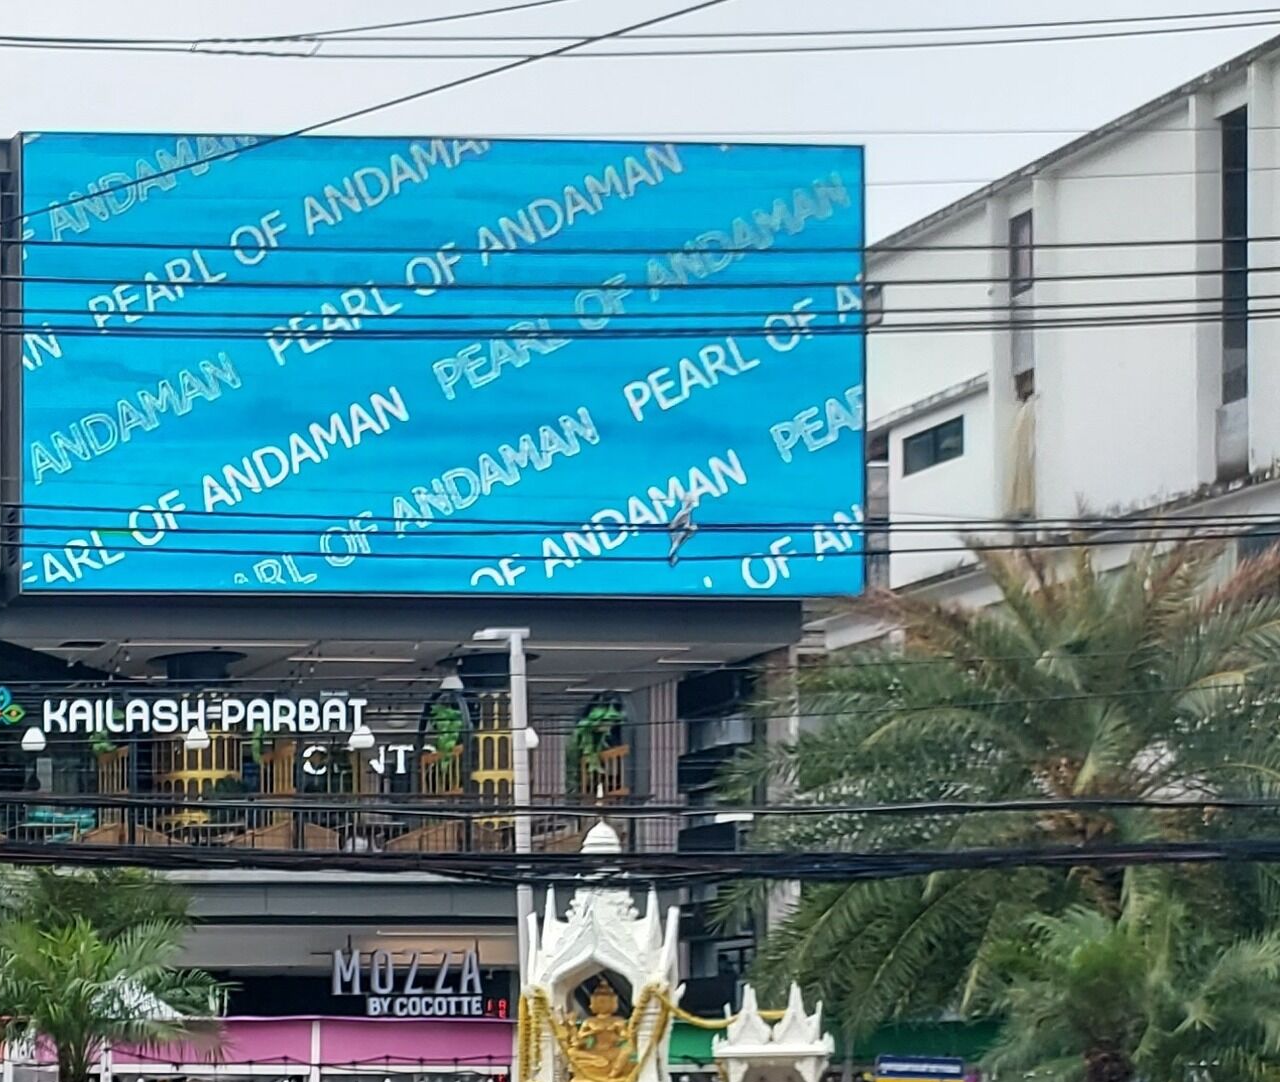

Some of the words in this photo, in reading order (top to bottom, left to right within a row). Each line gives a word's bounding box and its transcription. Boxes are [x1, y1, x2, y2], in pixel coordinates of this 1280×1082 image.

[30, 352, 241, 485] ANDAMAN
[265, 282, 402, 365] PEARL
[406, 242, 462, 296] OF
[477, 143, 684, 266] ANDAMAN
[89, 249, 227, 332] PEARL
[230, 210, 288, 266] OF
[304, 139, 490, 235] ANDAMA
[128, 490, 186, 545] OF
[202, 386, 410, 513] ANDAMAN
[432, 317, 573, 399] PEARL
[574, 273, 634, 330] OF
[645, 171, 851, 302] ANDAMAN
[319, 511, 378, 566] OF
[392, 406, 600, 538] ANDAMAN
[623, 336, 760, 421] PEARL
[764, 297, 817, 351] OF
[542, 448, 748, 578] ANDAMAN
[741, 536, 797, 589] OF
[331, 949, 483, 996] MOZZA
[367, 997, 390, 1016] BY
[393, 995, 483, 1016] COCOTTE
